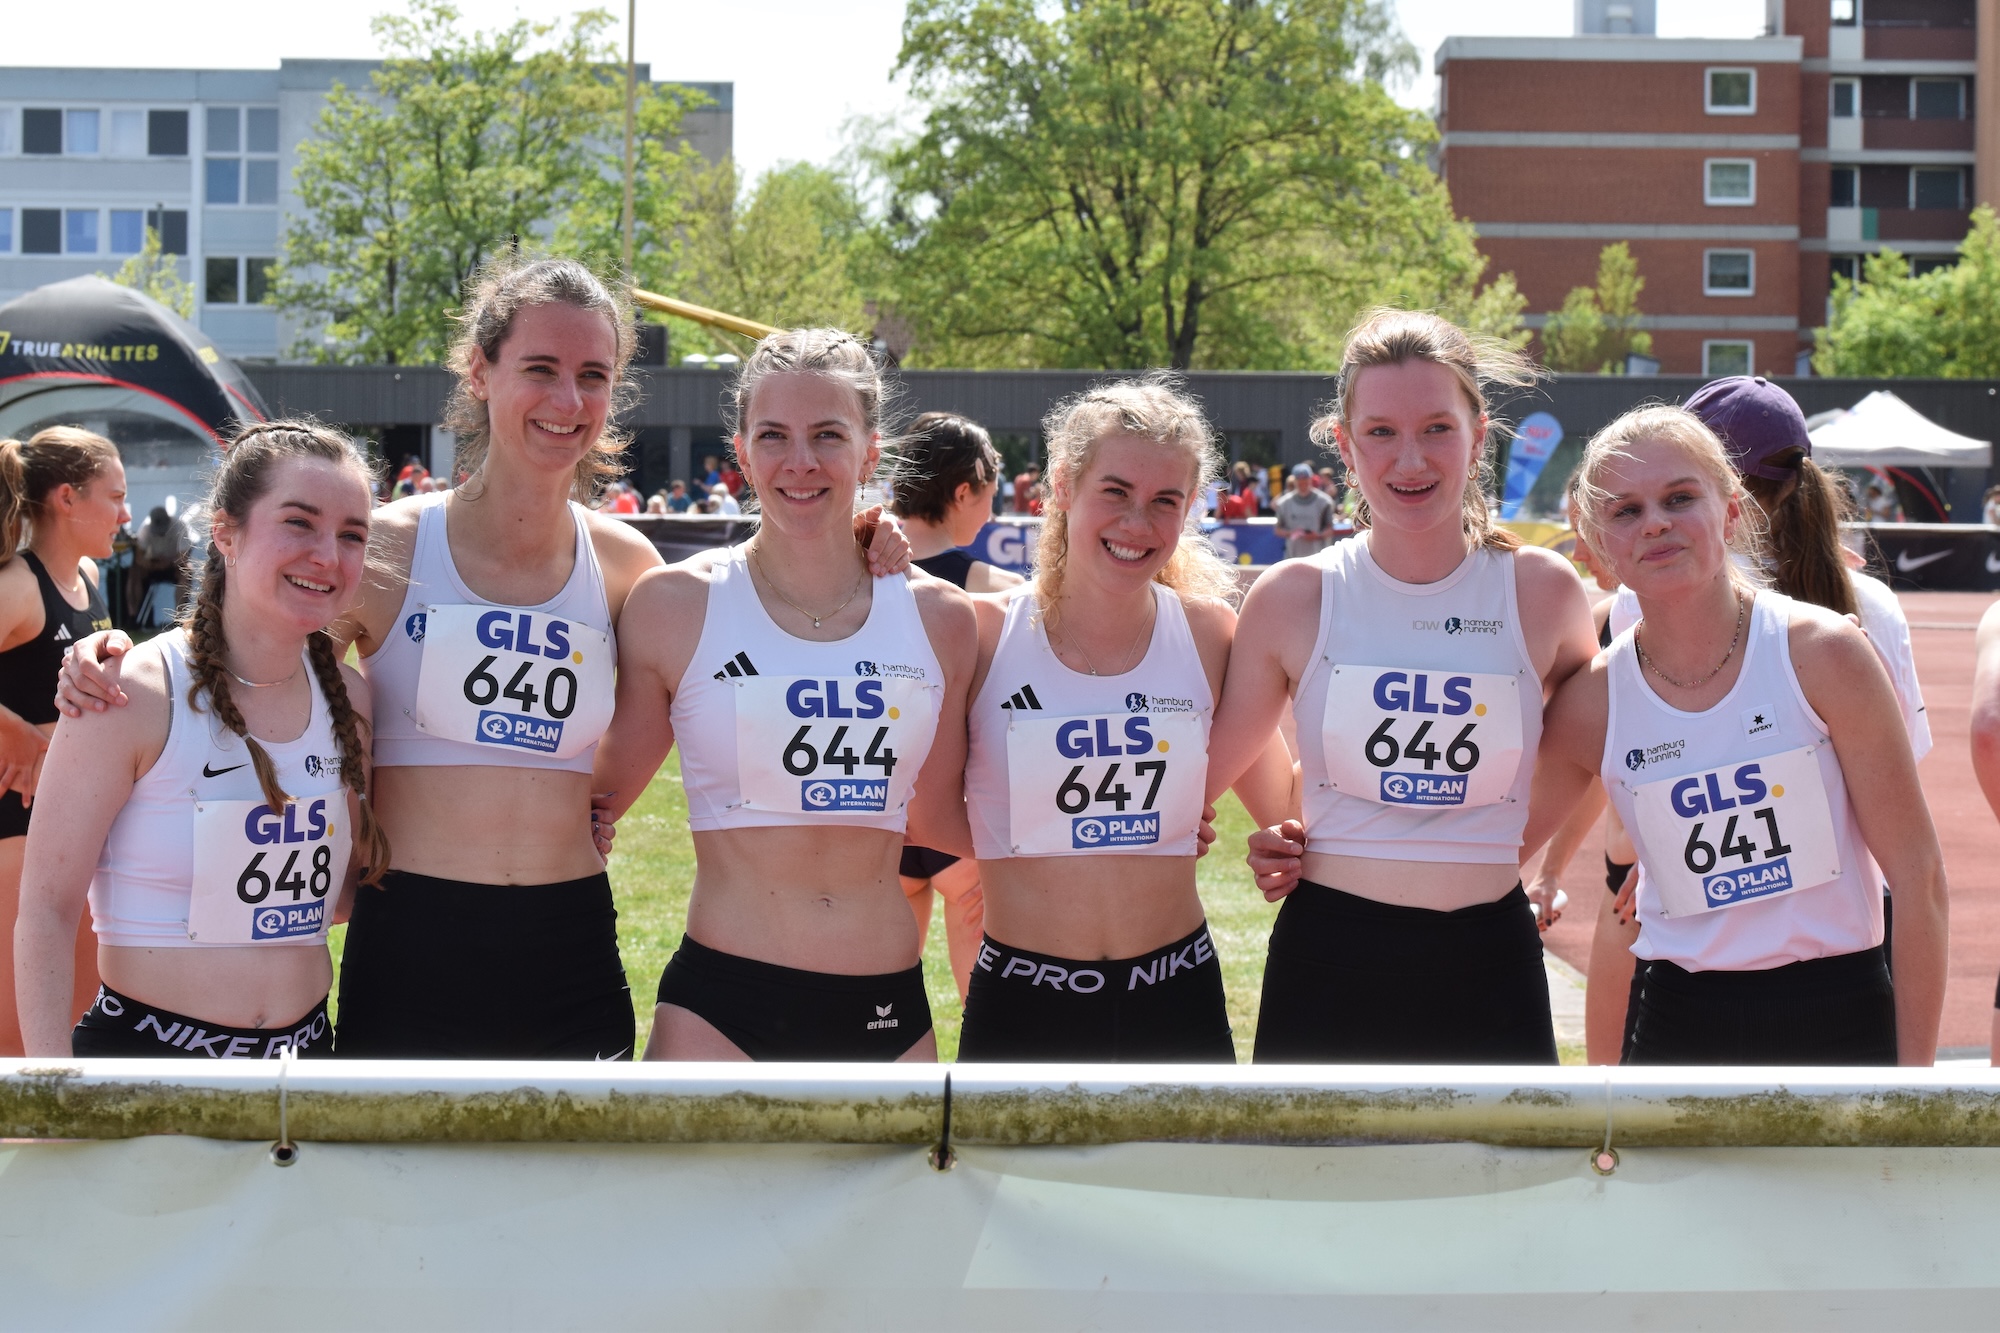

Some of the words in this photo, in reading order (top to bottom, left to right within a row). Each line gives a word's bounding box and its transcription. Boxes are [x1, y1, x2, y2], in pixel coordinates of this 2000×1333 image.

[10, 340, 159, 362] TRUEATHLETES
[1463, 618, 1503, 629] hamburg
[1463, 626, 1497, 635] running
[882, 663, 925, 678] hamburg
[463, 655, 578, 720] 640
[1151, 695, 1193, 709] hamburg
[515, 720, 560, 742] PLAN
[1748, 723, 1773, 735] SAYSKY
[513, 736, 555, 749] INTERNATIONAL
[782, 725, 898, 777] 644
[1364, 717, 1480, 773] 646
[1646, 739, 1685, 756] hamburg
[324, 755, 342, 766] hamb
[1647, 749, 1681, 765] running
[839, 784, 886, 800] PLAN
[1055, 760, 1167, 815] 647
[1416, 779, 1465, 795] PLAN
[1109, 818, 1157, 835] PLAN
[1684, 806, 1792, 875] 641
[236, 845, 331, 904] 648
[1738, 864, 1787, 889] PLAN
[1740, 880, 1789, 896] INTERNATIONAL
[287, 905, 323, 925] PLAN
[1001, 956, 1106, 994] PRO
[1127, 932, 1213, 991] NIKE
[866, 1018, 899, 1030] erima
[133, 1013, 260, 1060] NIKE
